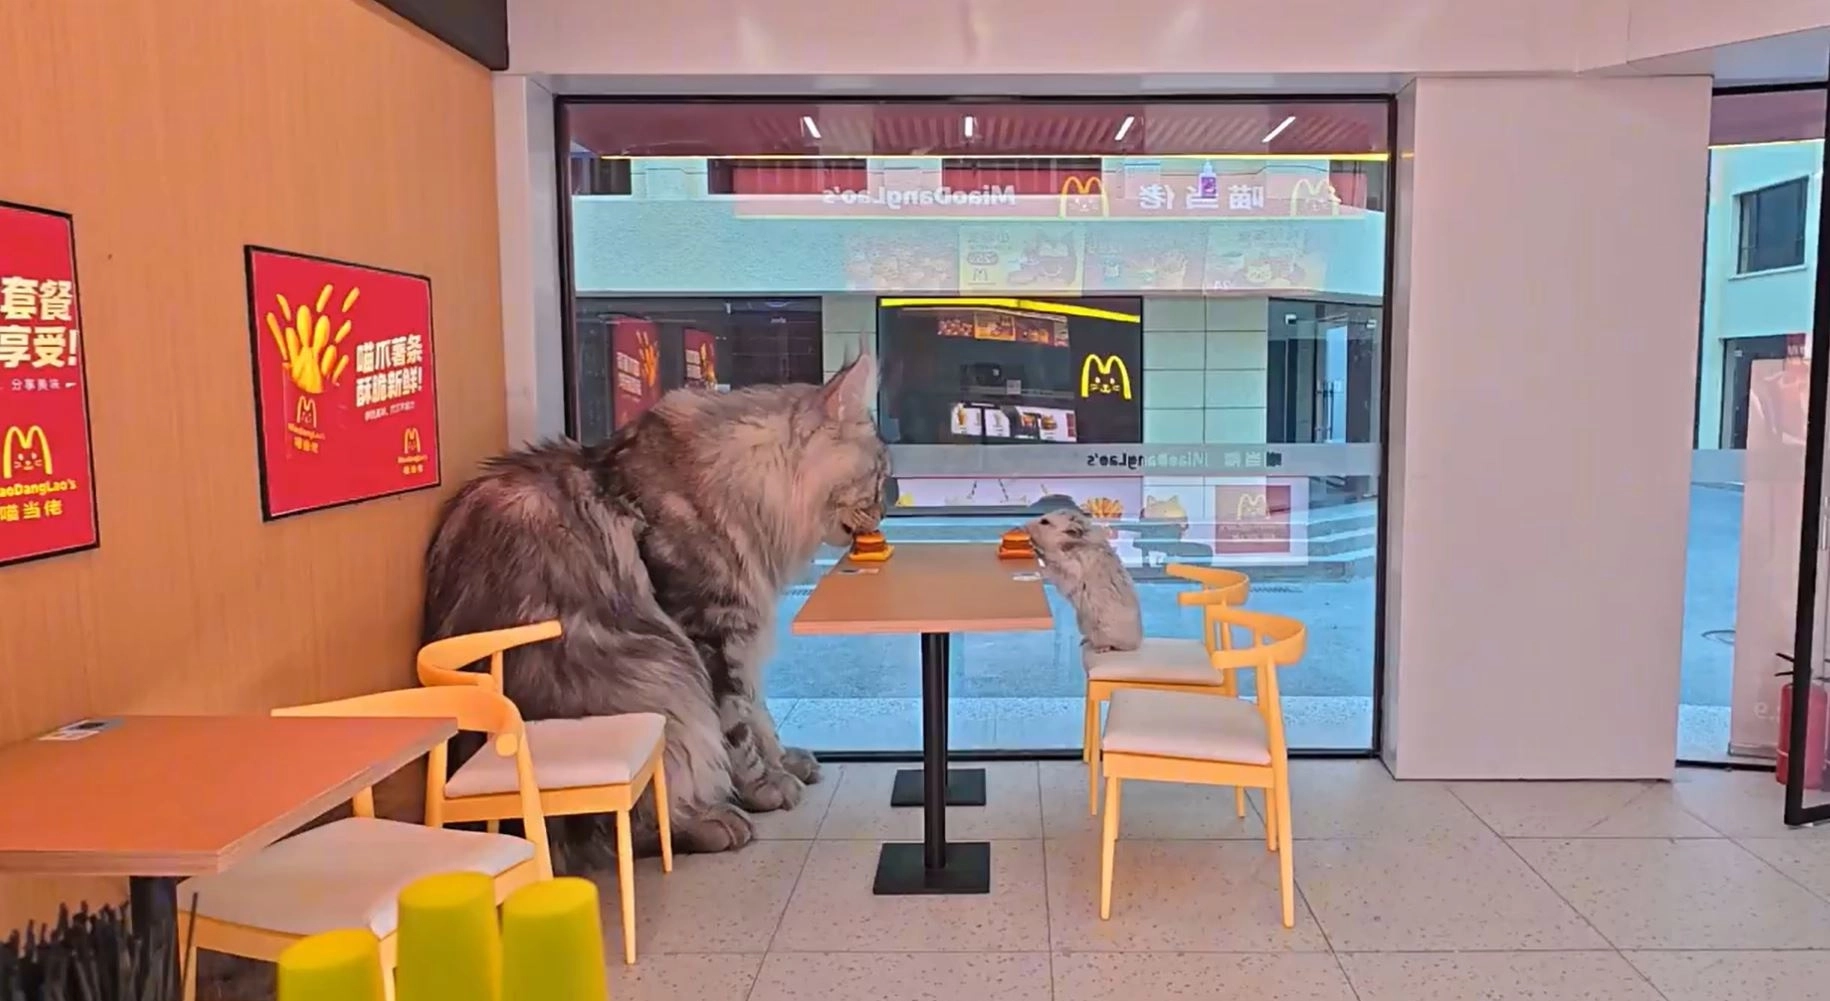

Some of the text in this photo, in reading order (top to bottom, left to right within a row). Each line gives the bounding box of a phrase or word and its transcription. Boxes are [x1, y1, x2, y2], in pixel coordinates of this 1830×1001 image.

[0, 276, 73, 321] 套餐
[356, 333, 423, 374] 喵爪薯条
[0, 499, 63, 522] 喵当佬
